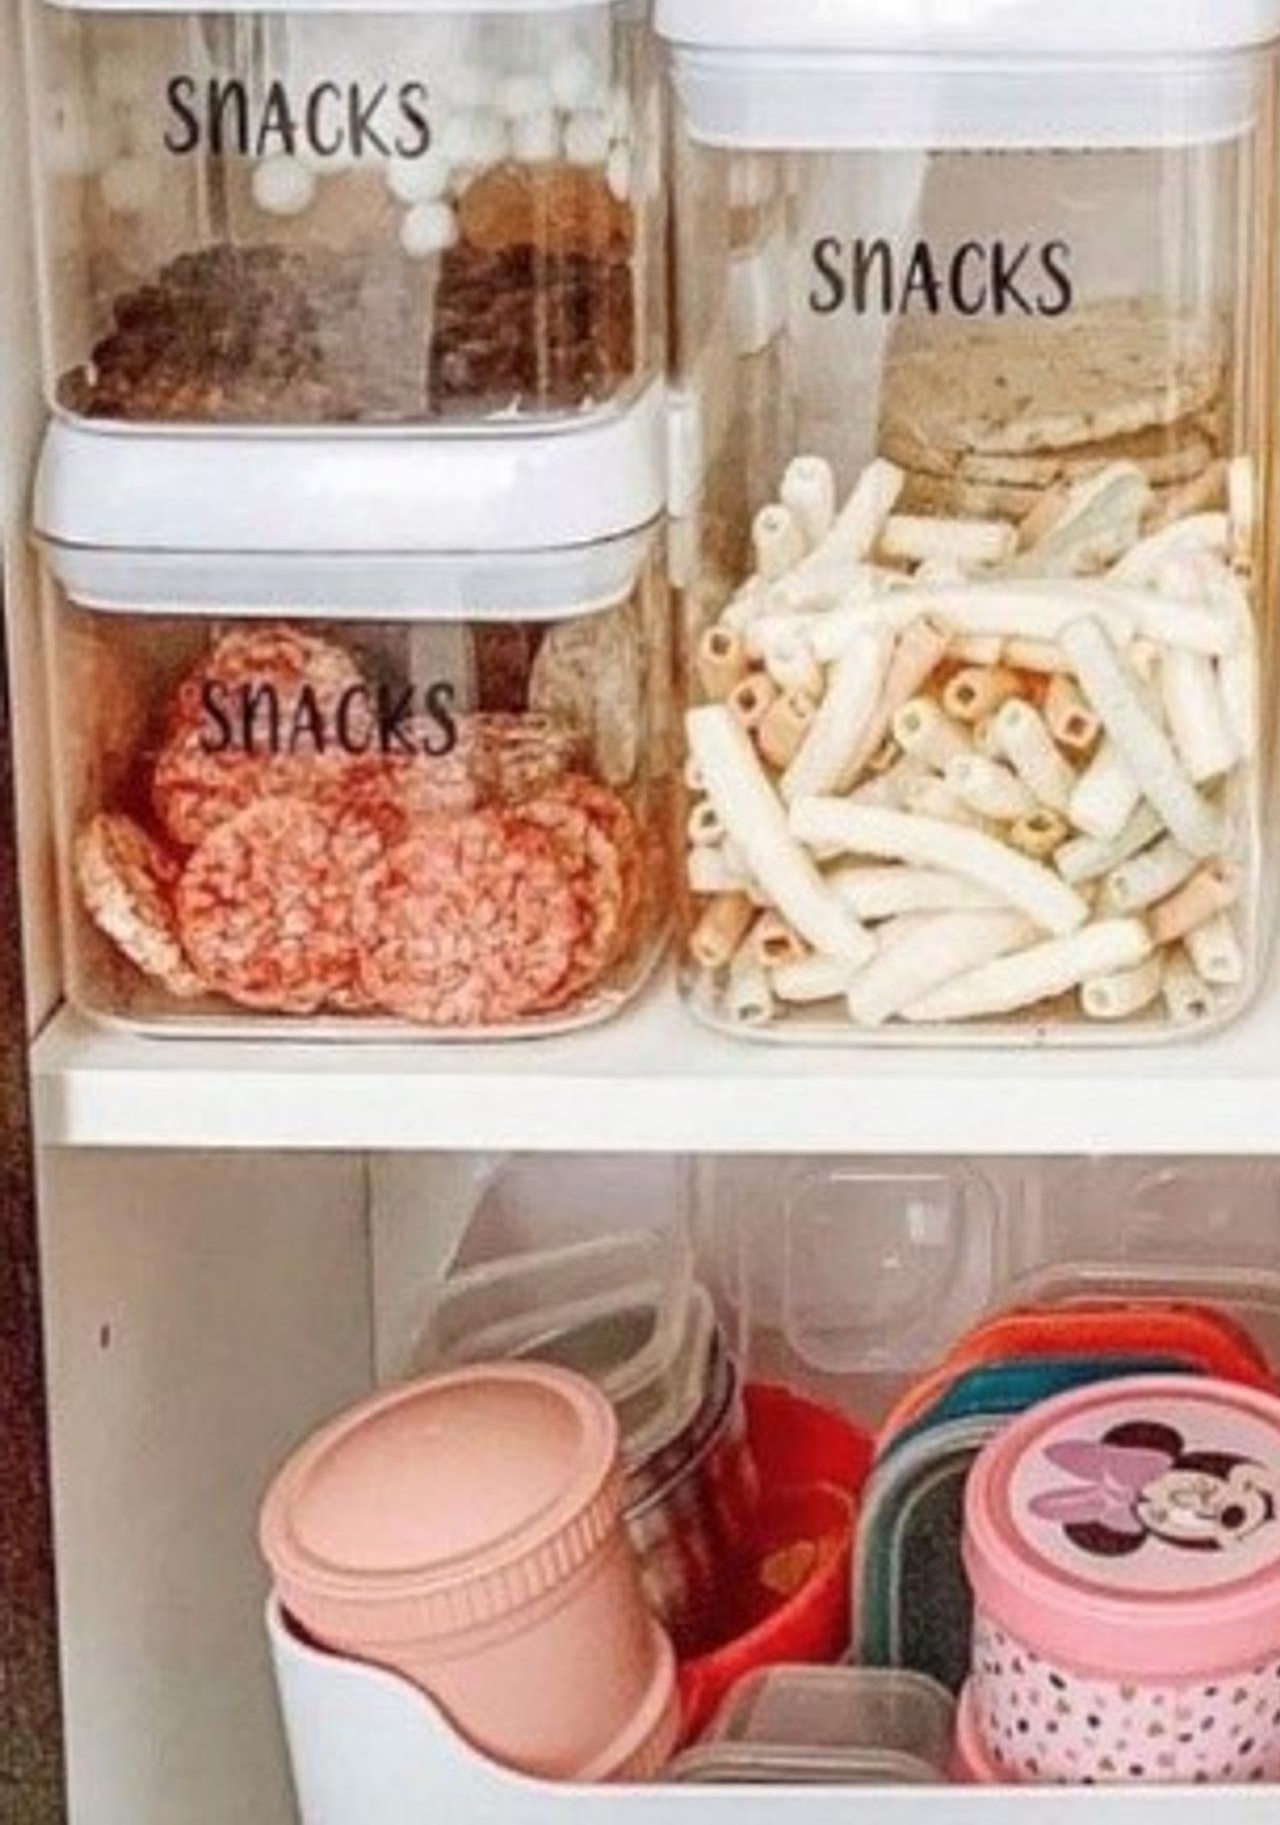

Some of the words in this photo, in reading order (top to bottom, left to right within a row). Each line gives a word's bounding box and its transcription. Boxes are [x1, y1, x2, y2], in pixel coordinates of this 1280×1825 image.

[163, 76, 432, 159] SNACKS
[809, 237, 1073, 318] SNACKS
[199, 681, 458, 758] SNACKS
